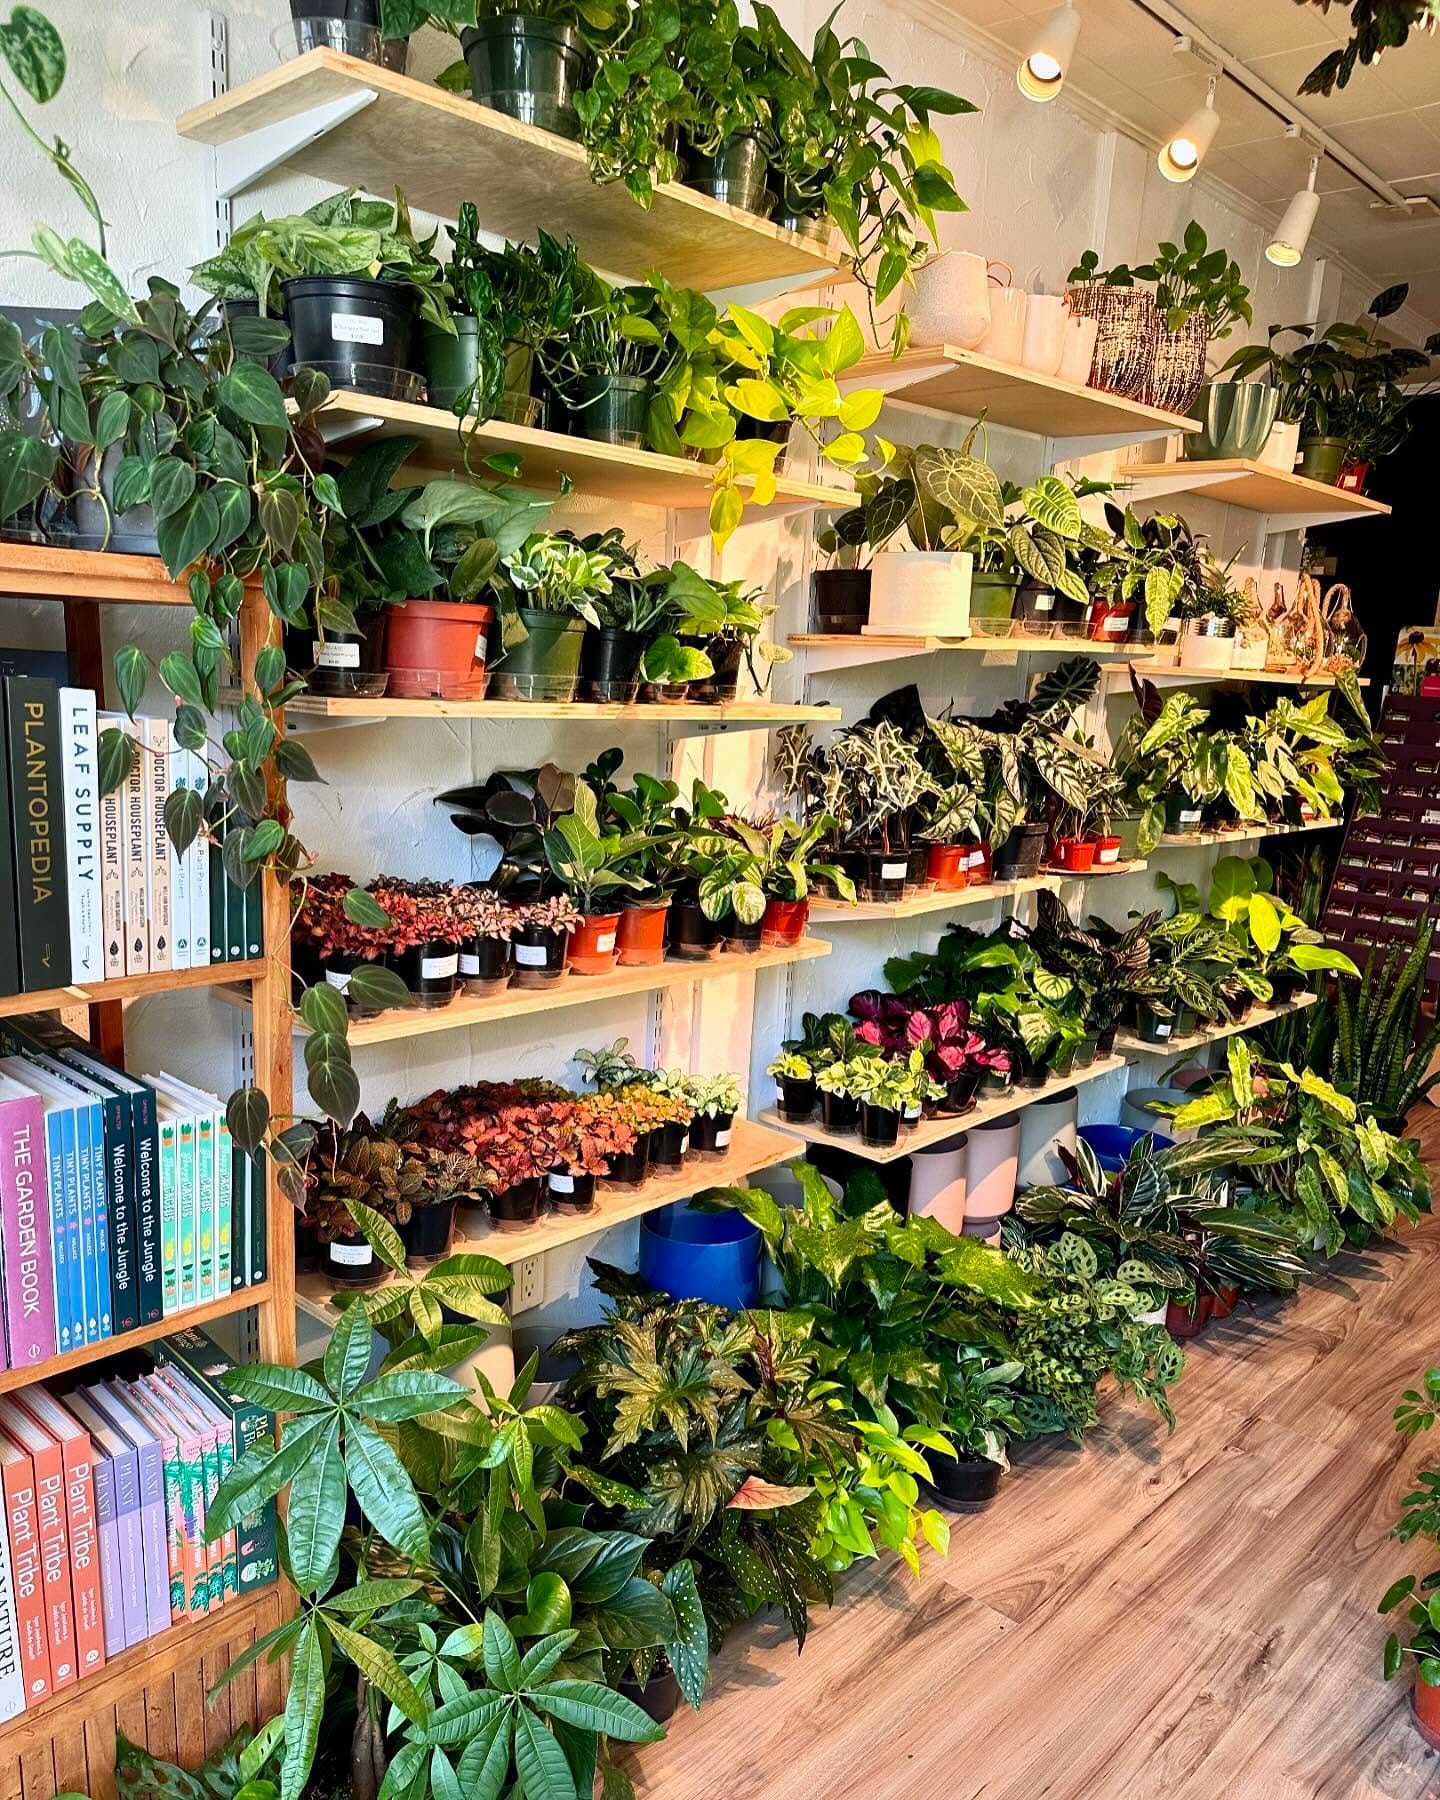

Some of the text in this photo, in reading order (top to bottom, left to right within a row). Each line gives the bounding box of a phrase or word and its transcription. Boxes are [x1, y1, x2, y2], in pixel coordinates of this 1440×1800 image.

[72, 707, 90, 776] LEAF
[24, 702, 53, 904] PLANTOPEDIA
[75, 788, 95, 882] SUPPLY
[105, 797, 118, 865] HOUSEPLANT
[130, 796, 142, 863] HOUSEPLANT
[153, 752, 167, 861] DOCTOR HOUSEPLANT
[53, 1154, 64, 1219] TINY PLANTS
[66, 1151, 77, 1215] TINY PLANTS
[81, 1147, 92, 1210] TINY PLANTS
[94, 1144, 105, 1208] TINY PLANTS
[140, 1137, 152, 1197] Welcome
[200, 1178, 212, 1214] CACTUS
[219, 1172, 230, 1208] CACTUS
[13, 1124, 40, 1319] THE GARDEN BOOK
[113, 1143, 129, 1290] Welcome to the Jungle
[141, 1199, 153, 1214] to
[142, 1215, 153, 1236] the
[163, 1186, 175, 1223] CACTUS
[182, 1182, 193, 1218] CACTUS
[142, 1238, 157, 1282] Jungle
[97, 1472, 111, 1516] PLANT
[120, 1463, 134, 1505] PLANT
[146, 1453, 159, 1495] PLANT
[11, 1487, 40, 1598] Plant Tribe
[40, 1474, 67, 1583] Plant Tribe
[69, 1462, 95, 1569] Plant Tribe
